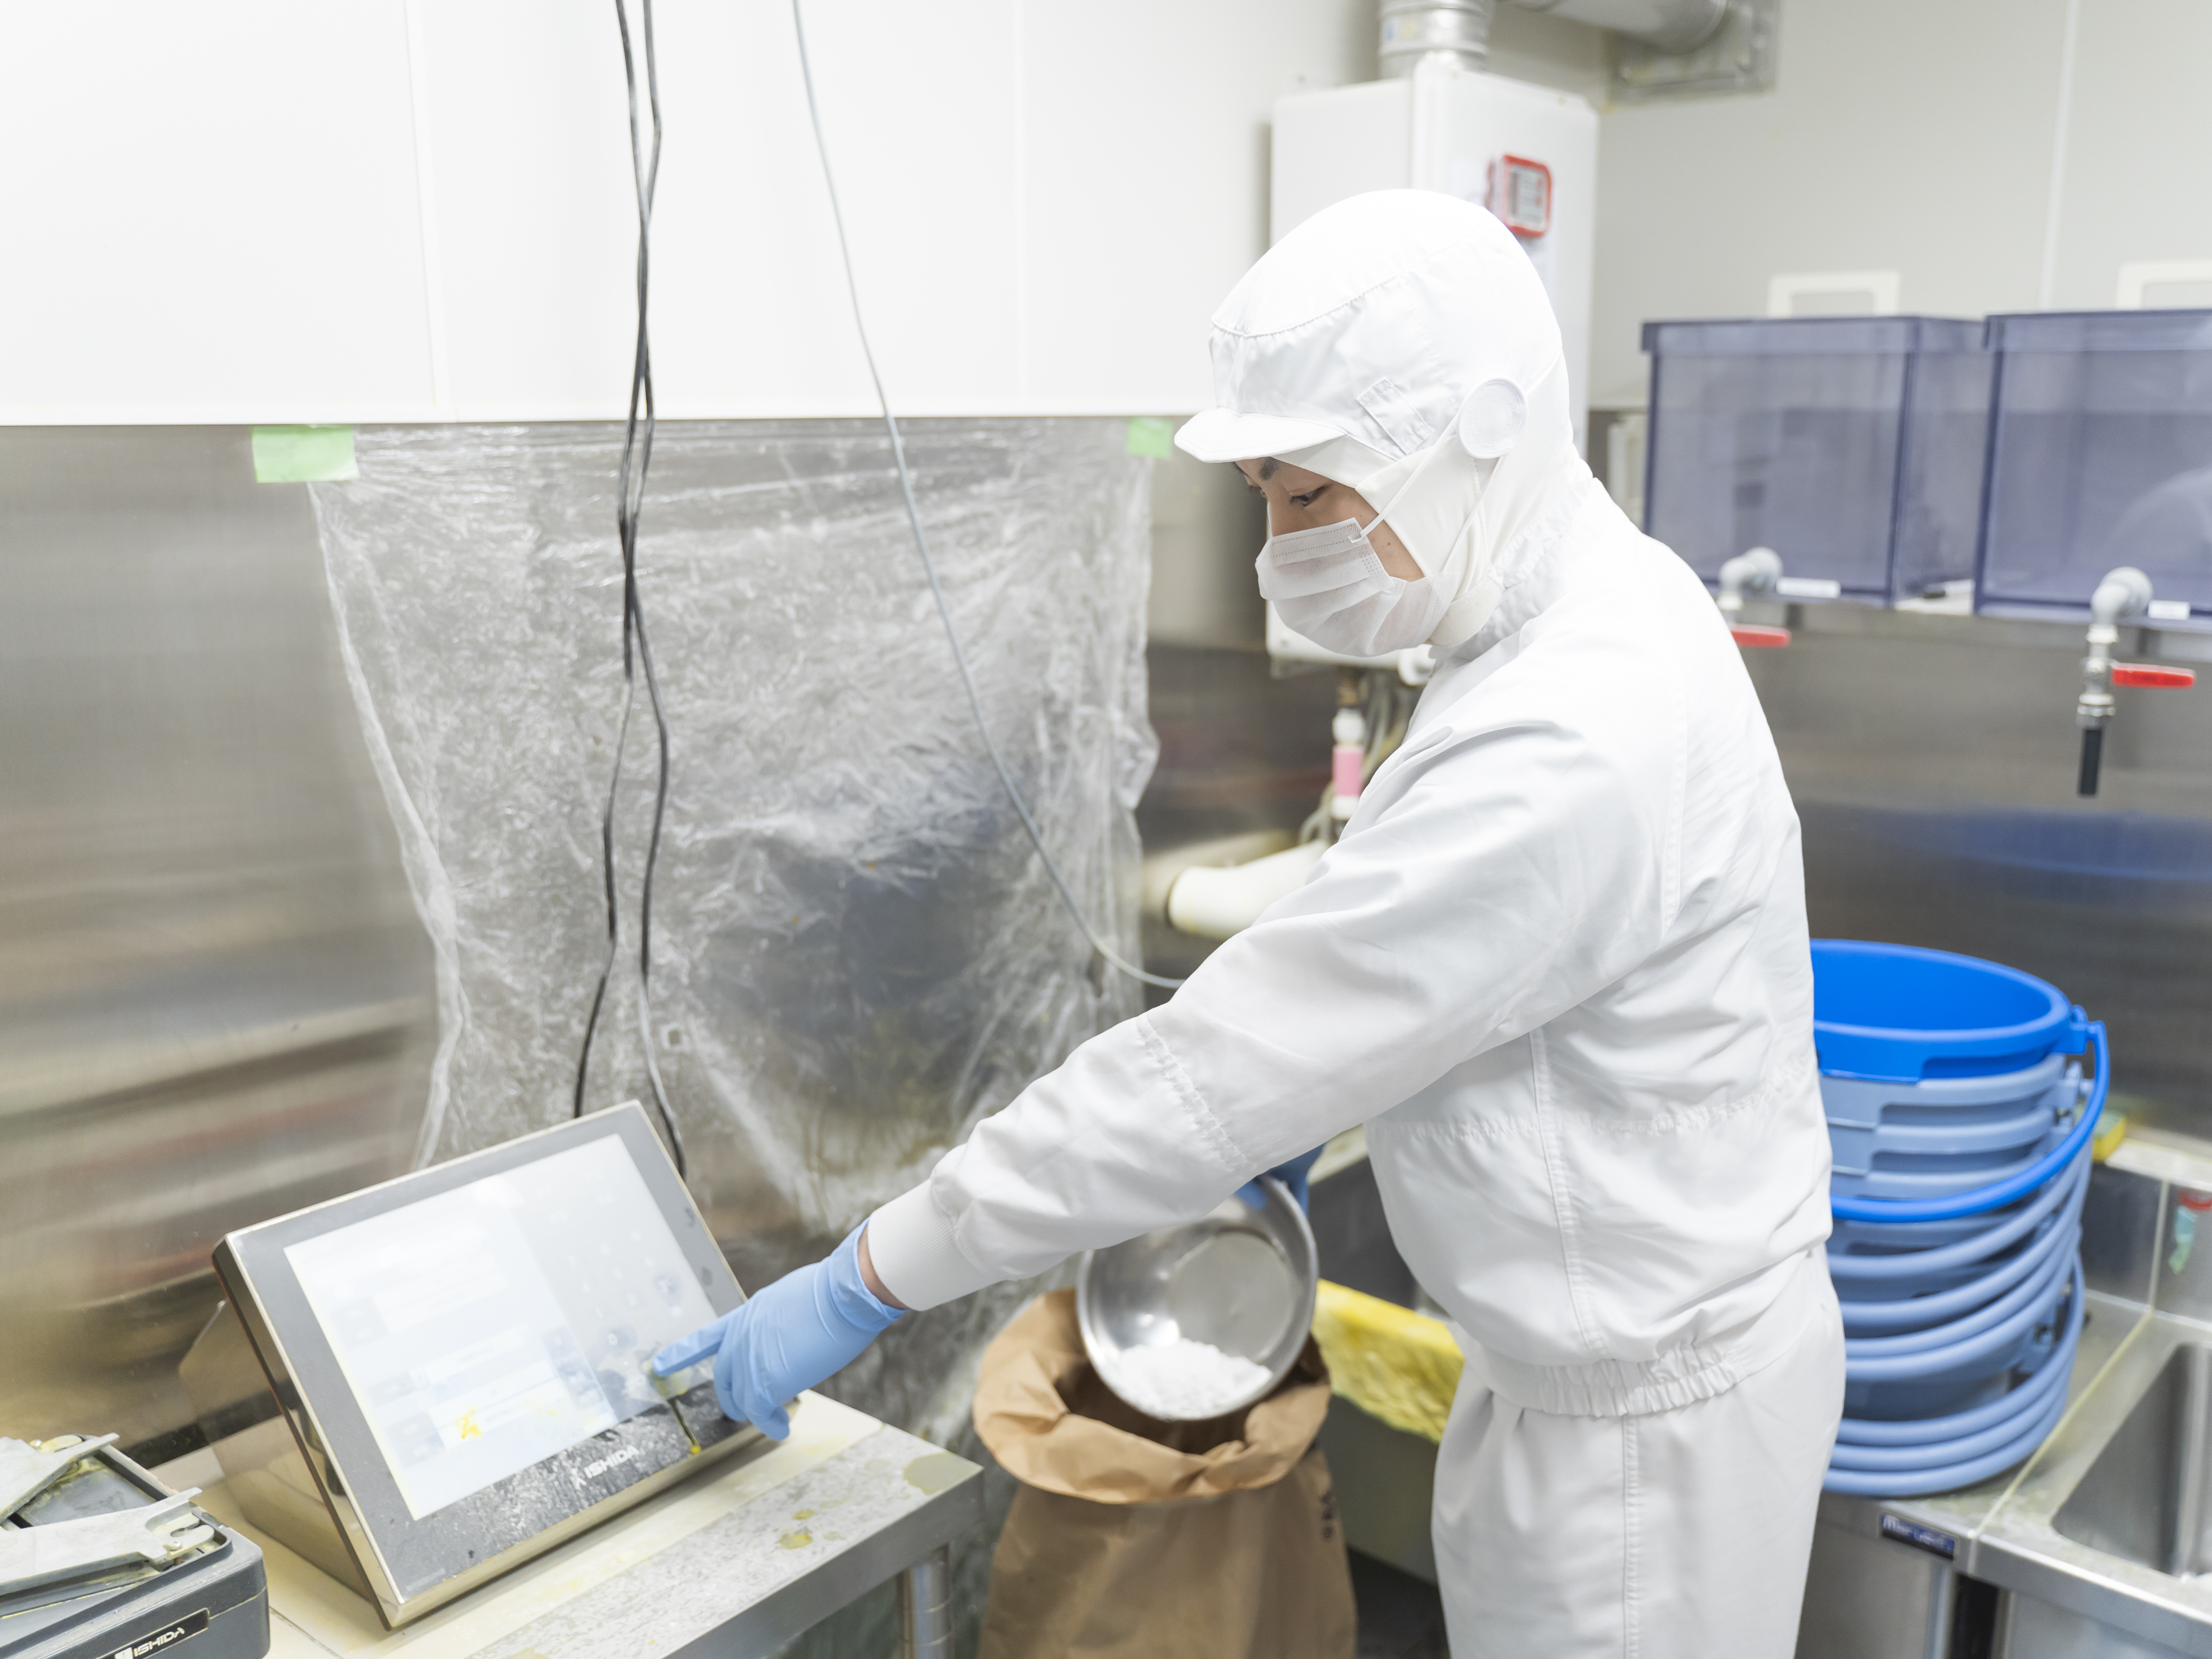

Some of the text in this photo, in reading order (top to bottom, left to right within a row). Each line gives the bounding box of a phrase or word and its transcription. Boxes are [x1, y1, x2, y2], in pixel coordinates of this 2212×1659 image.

[607, 1333, 618, 1346] 0
[583, 1444, 641, 1479] ISHIDA
[133, 1627, 185, 1657] ISHIDA
